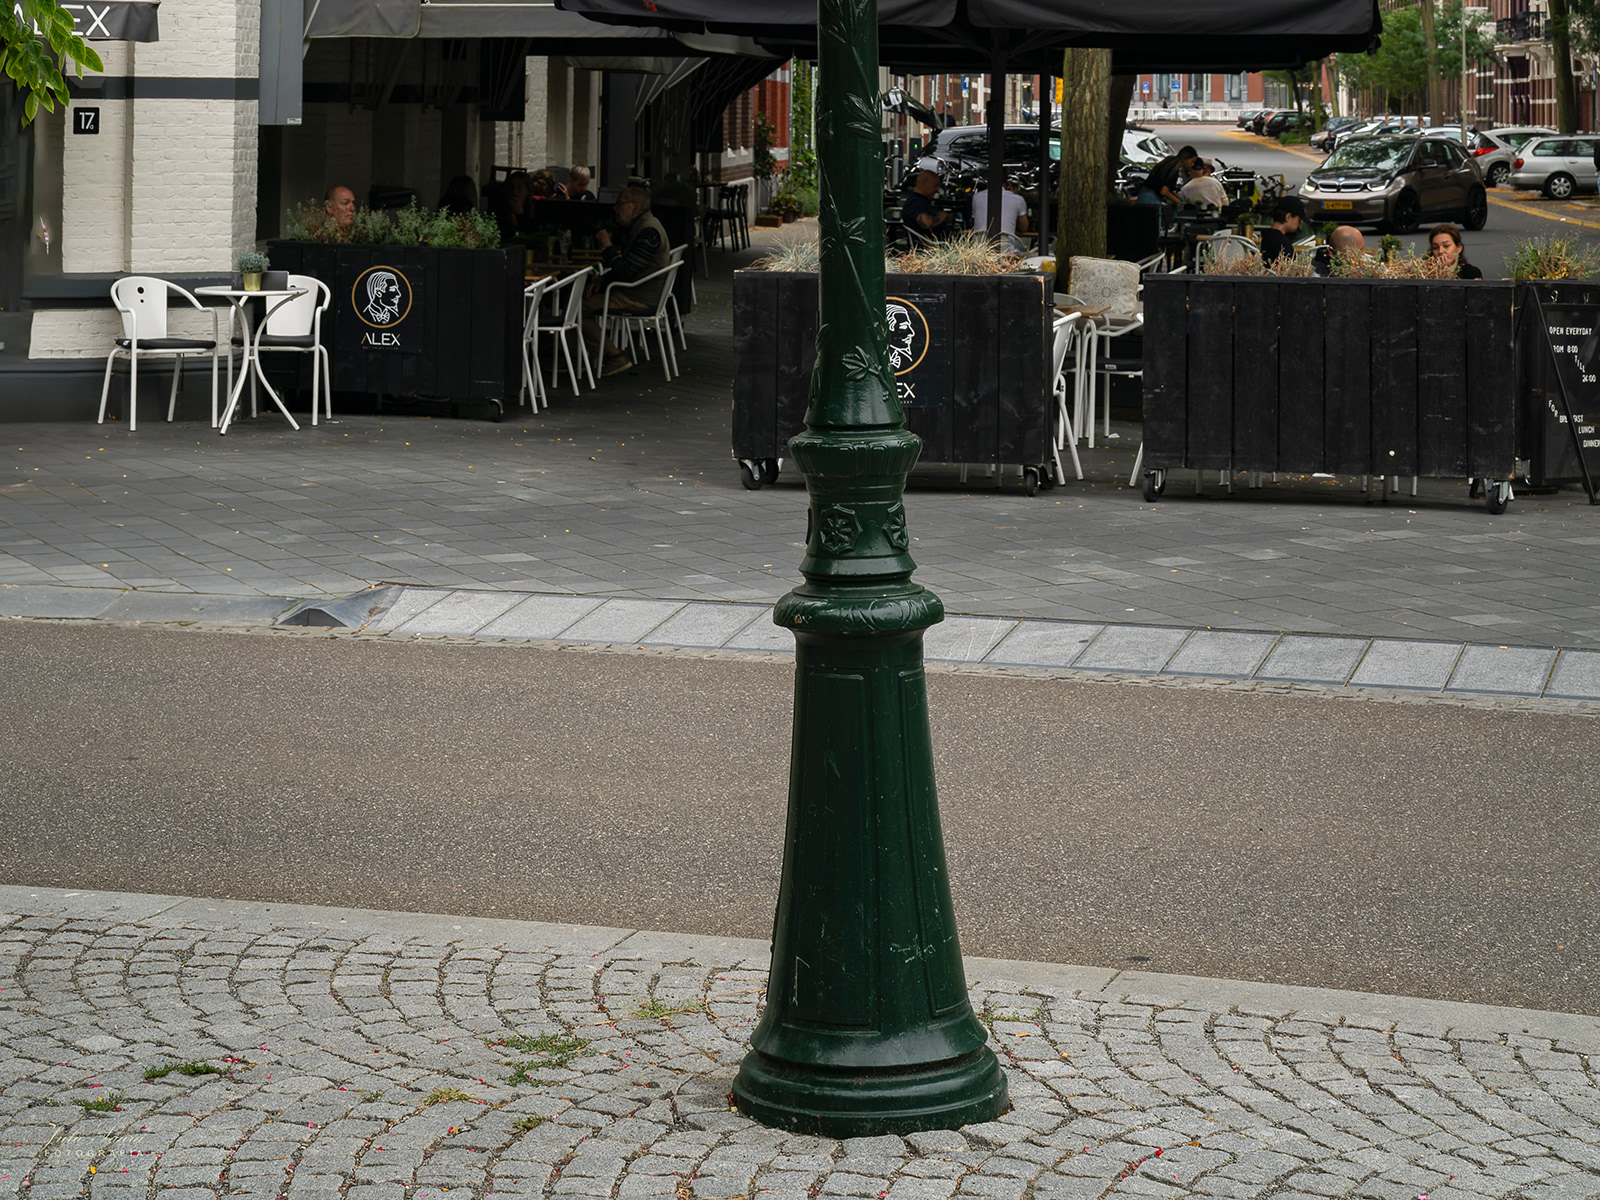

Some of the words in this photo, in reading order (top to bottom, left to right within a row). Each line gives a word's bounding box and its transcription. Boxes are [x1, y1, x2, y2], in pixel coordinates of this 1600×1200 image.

[1549, 326, 1564, 335] OPEN
[1565, 327, 1592, 336] EVERYDAY
[361, 332, 401, 346] ALEX
[1552, 344, 1564, 353] ROM
[1574, 355, 1585, 373] TILL
[896, 382, 916, 399] EX
[1548, 400, 1558, 418] FOR
[1578, 425, 1595, 434] LUNCH
